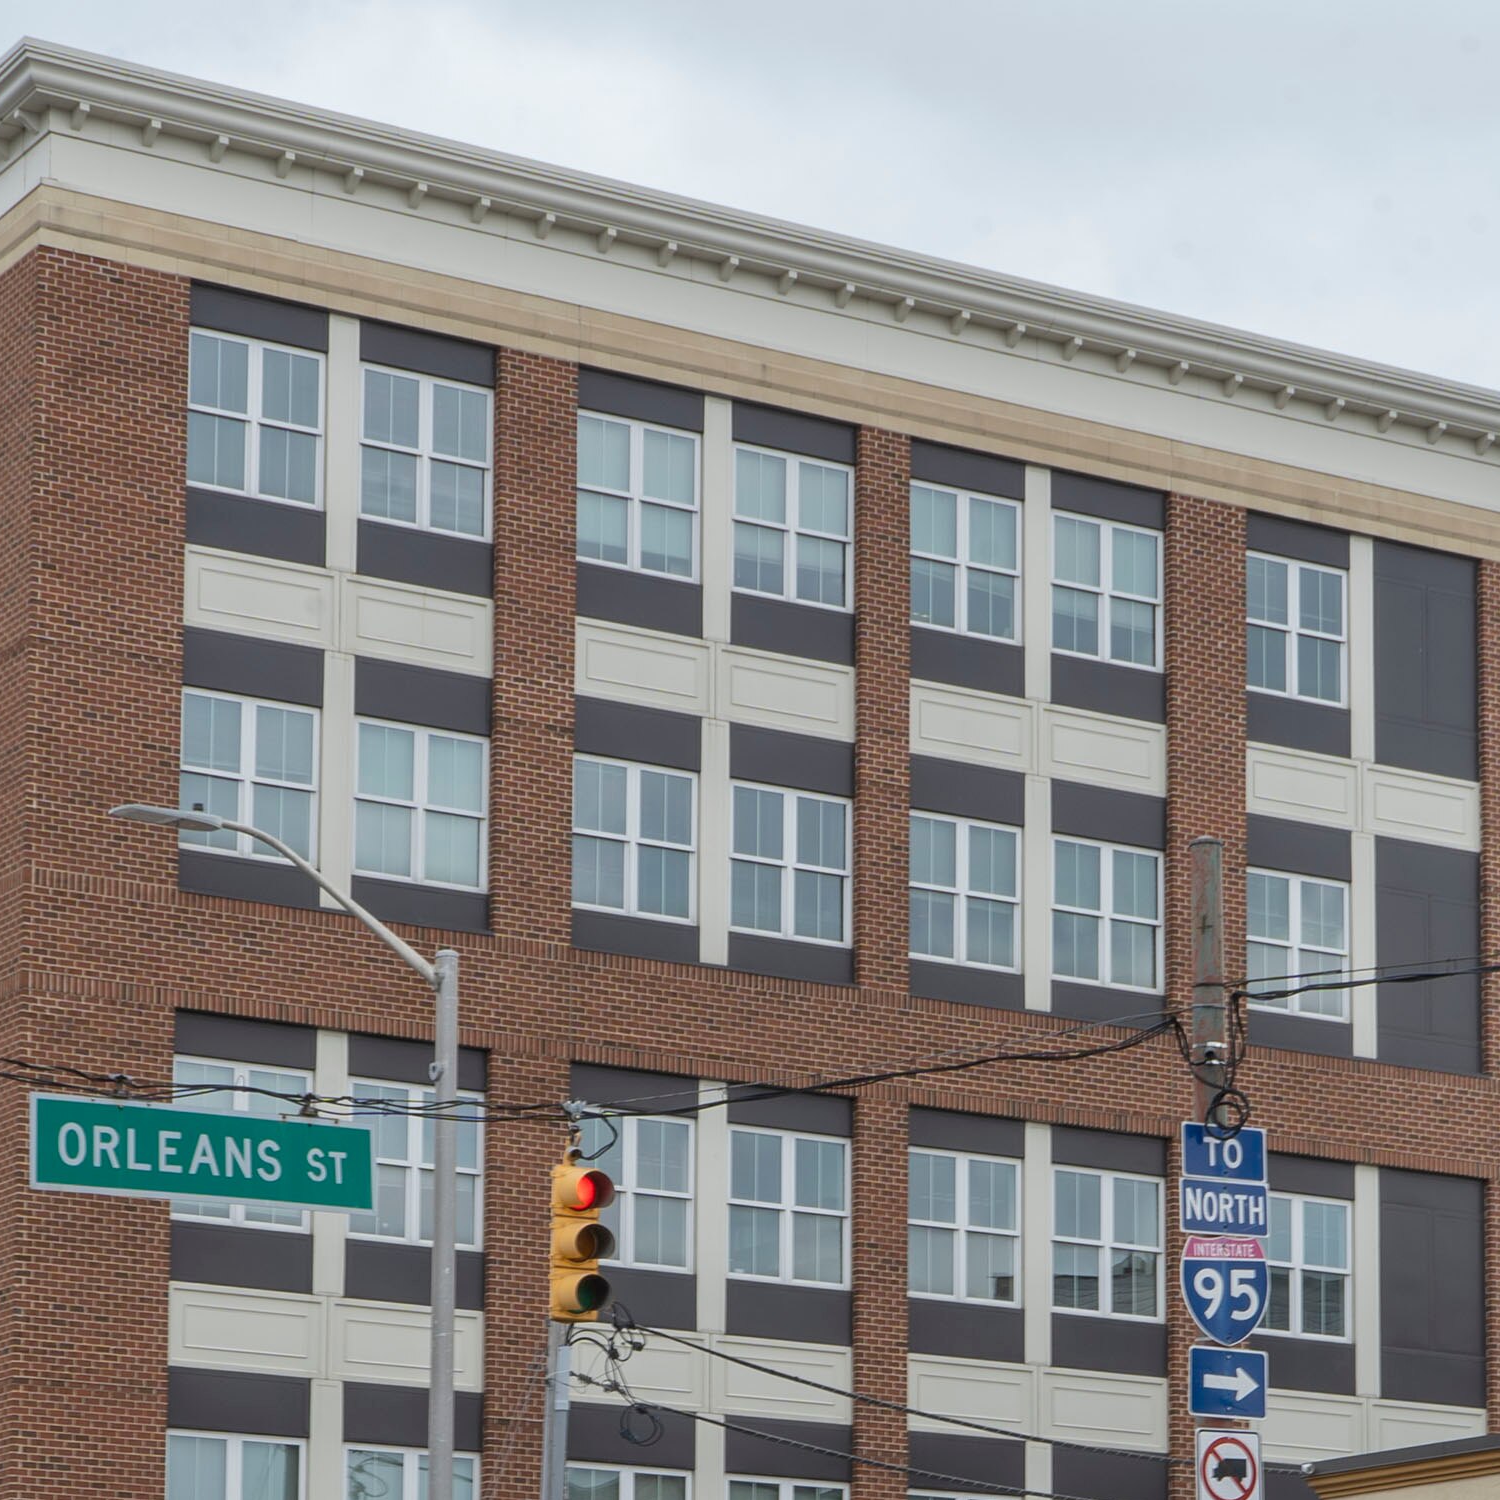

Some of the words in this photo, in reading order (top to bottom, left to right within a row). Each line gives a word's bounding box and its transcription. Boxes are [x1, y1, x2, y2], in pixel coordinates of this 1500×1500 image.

[57, 1121, 283, 1182] ORLEANS
[307, 1148, 347, 1184] ST
[1203, 1136, 1244, 1169] TO
[1185, 1187, 1265, 1226] NORTH
[1193, 1243, 1255, 1258] INTERSTATE
[1193, 1268, 1260, 1321] 95
